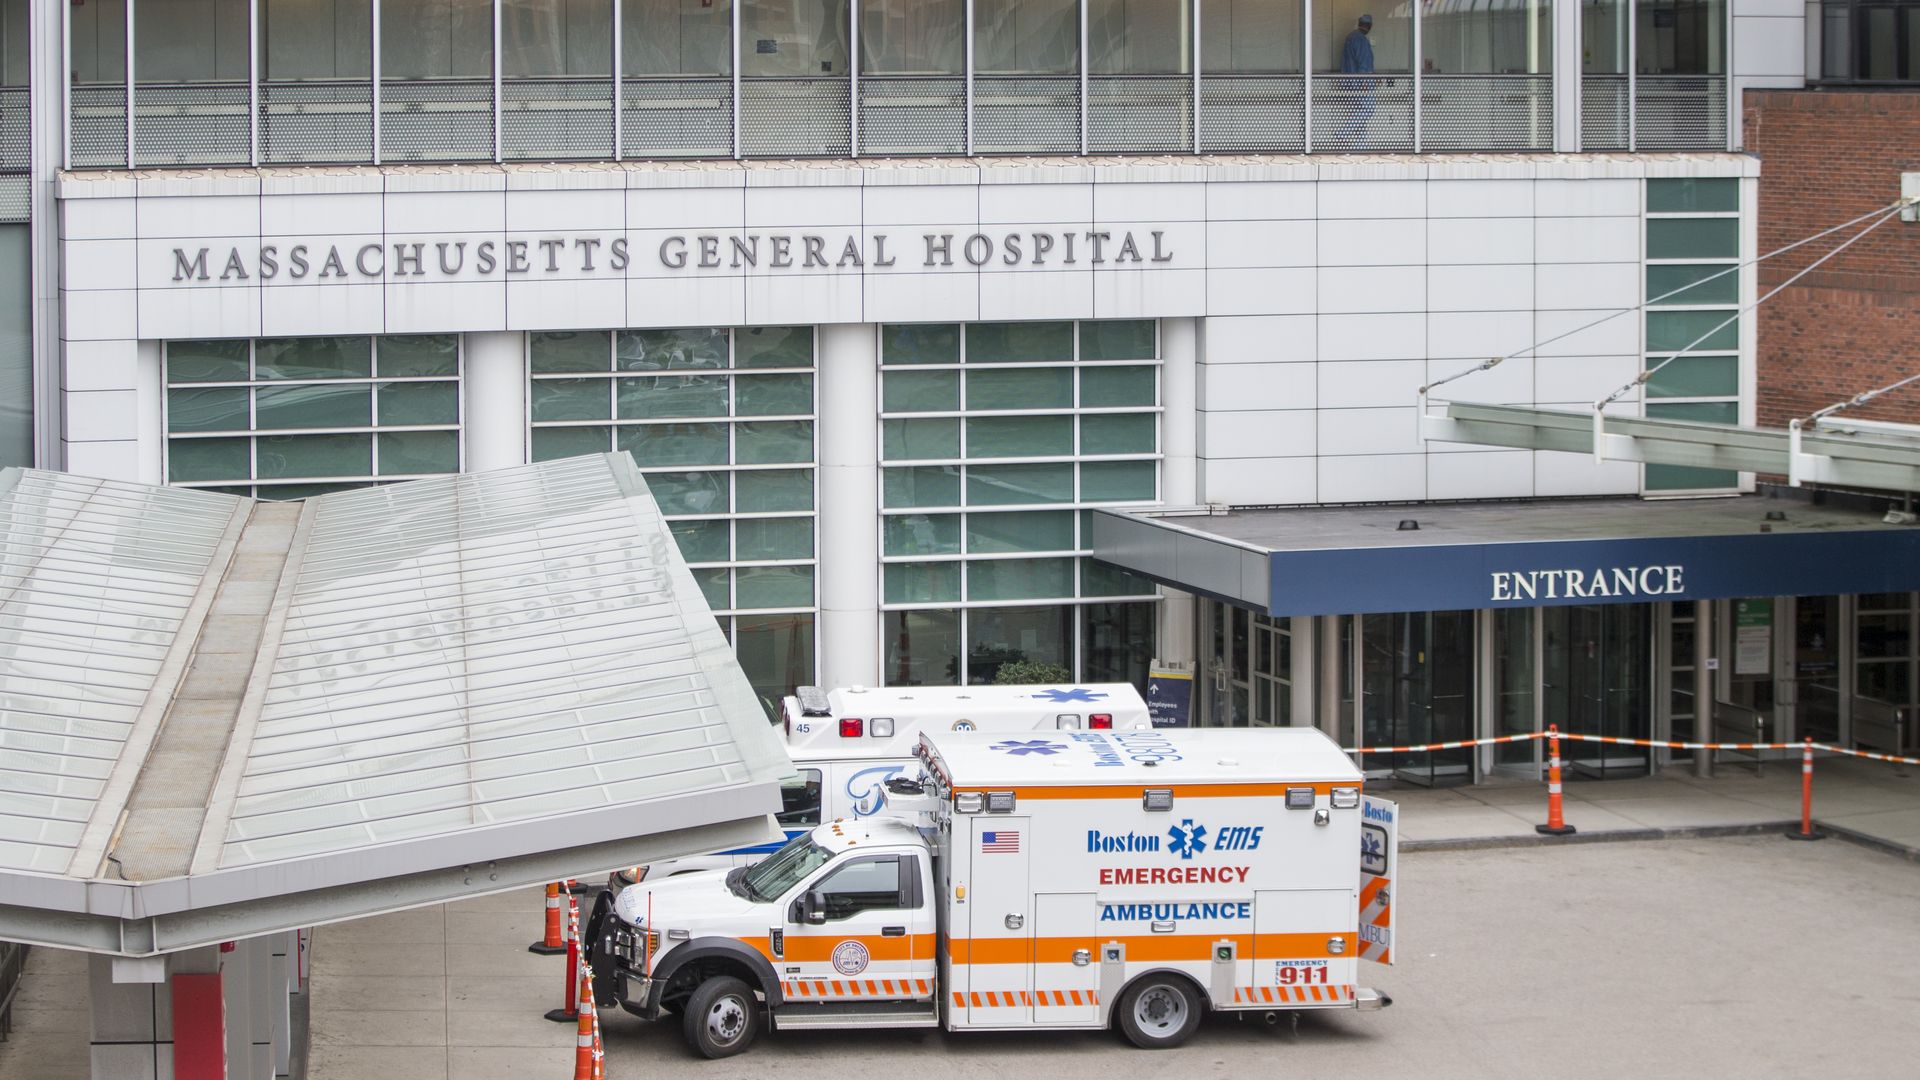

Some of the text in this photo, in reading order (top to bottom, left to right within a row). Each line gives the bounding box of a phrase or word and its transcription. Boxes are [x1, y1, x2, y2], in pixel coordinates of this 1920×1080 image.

[172, 231, 1174, 281] MASSACHUSETTS GENERAL HOSPITAL
[1490, 565, 1685, 600] ENTRANCE
[1148, 701, 1177, 709] Employees
[796, 723, 810, 733] 45
[1364, 801, 1392, 823] Bosto
[1087, 826, 1264, 853] Boston EMS
[1099, 866, 1250, 885] EMERGENCY
[1100, 902, 1250, 921] AMBULANCE
[1359, 922, 1391, 946] MBU
